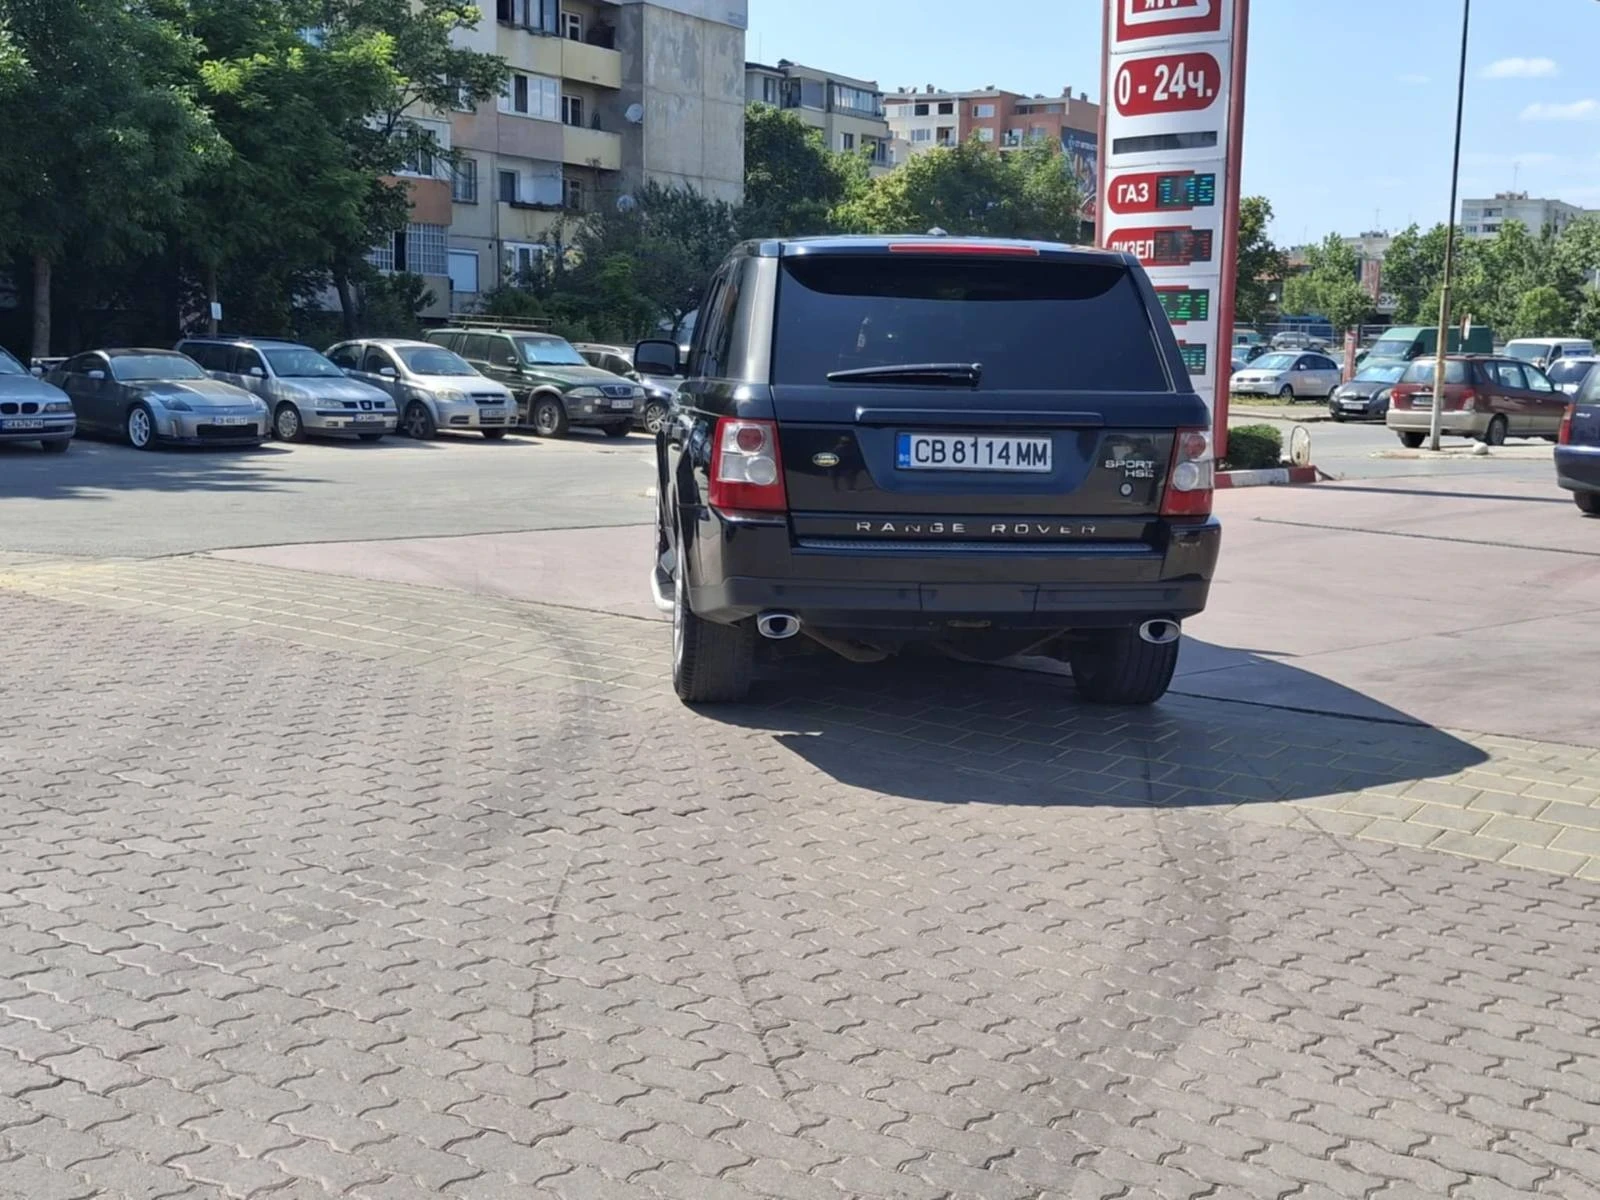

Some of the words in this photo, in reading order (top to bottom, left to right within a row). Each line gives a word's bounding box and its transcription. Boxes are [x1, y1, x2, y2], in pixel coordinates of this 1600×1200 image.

[1119, 69, 1131, 105] 0
[1153, 62, 1212, 101] 24ч.
[1117, 182, 1149, 204] ГАЗ
[915, 439, 946, 463] CB
[952, 439, 1011, 466] 8114
[1016, 441, 1048, 467] MM
[1105, 459, 1154, 469] SPORT
[856, 521, 966, 534] RANGE
[991, 523, 1096, 535] ROVER
